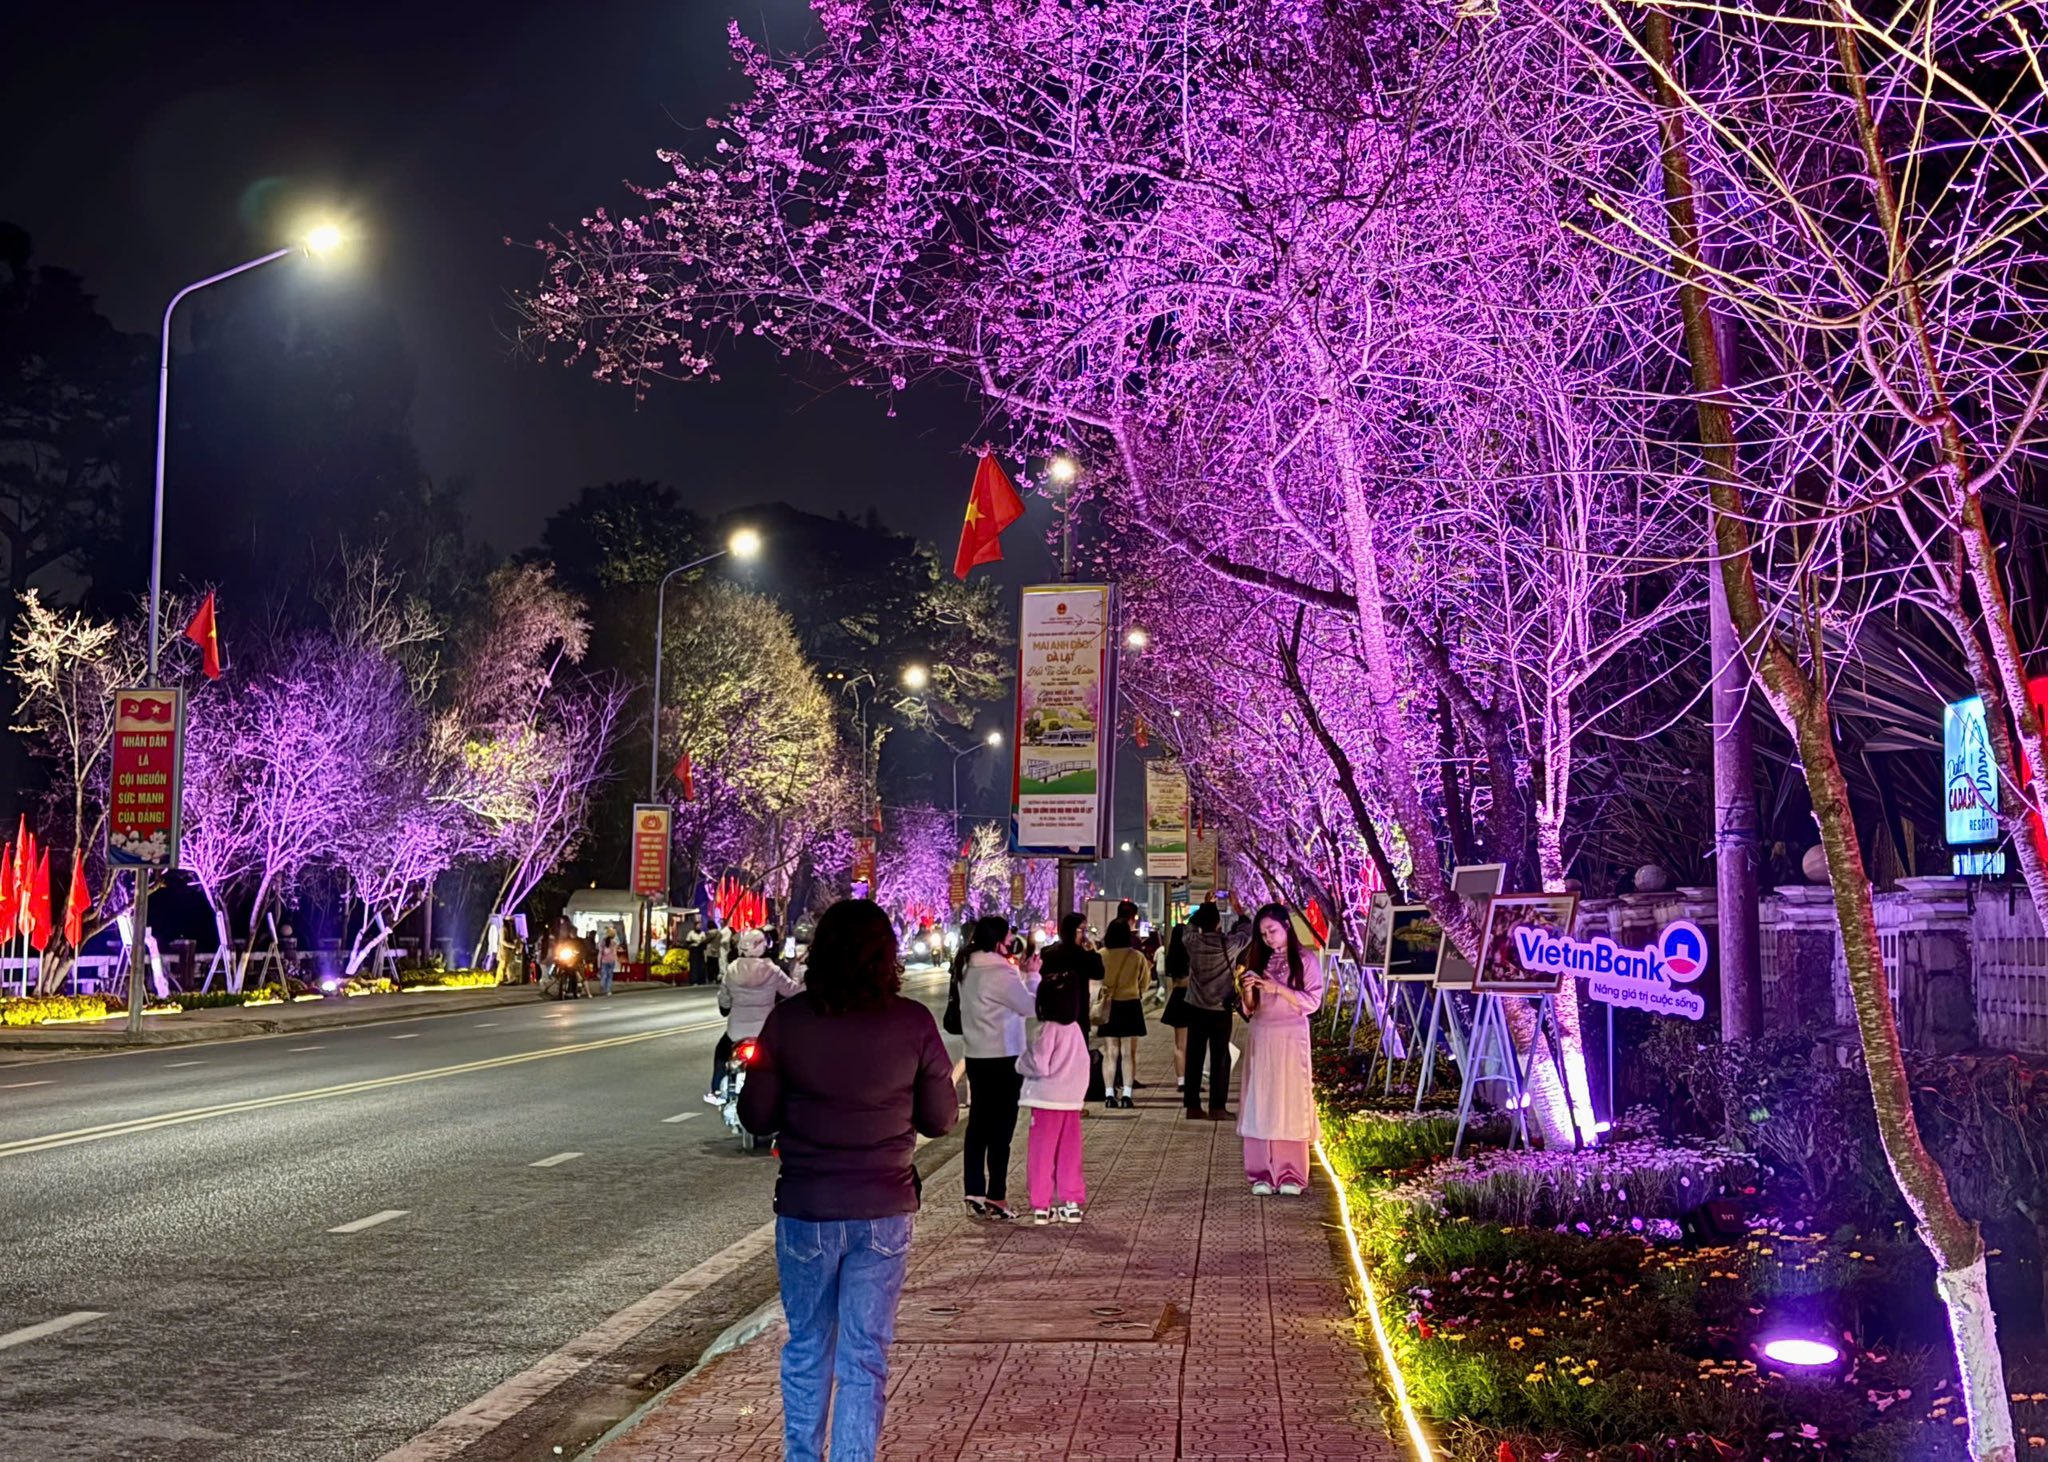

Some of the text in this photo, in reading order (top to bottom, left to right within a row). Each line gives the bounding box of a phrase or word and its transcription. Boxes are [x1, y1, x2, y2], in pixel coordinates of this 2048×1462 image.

[1969, 818, 1994, 831] RESORT
[1520, 933, 1666, 982] VietinBank
[1621, 988, 1637, 1000] giá
[1639, 991, 1649, 1004] trị
[1650, 994, 1673, 1007] cuộc
[1675, 996, 1698, 1012] sống
